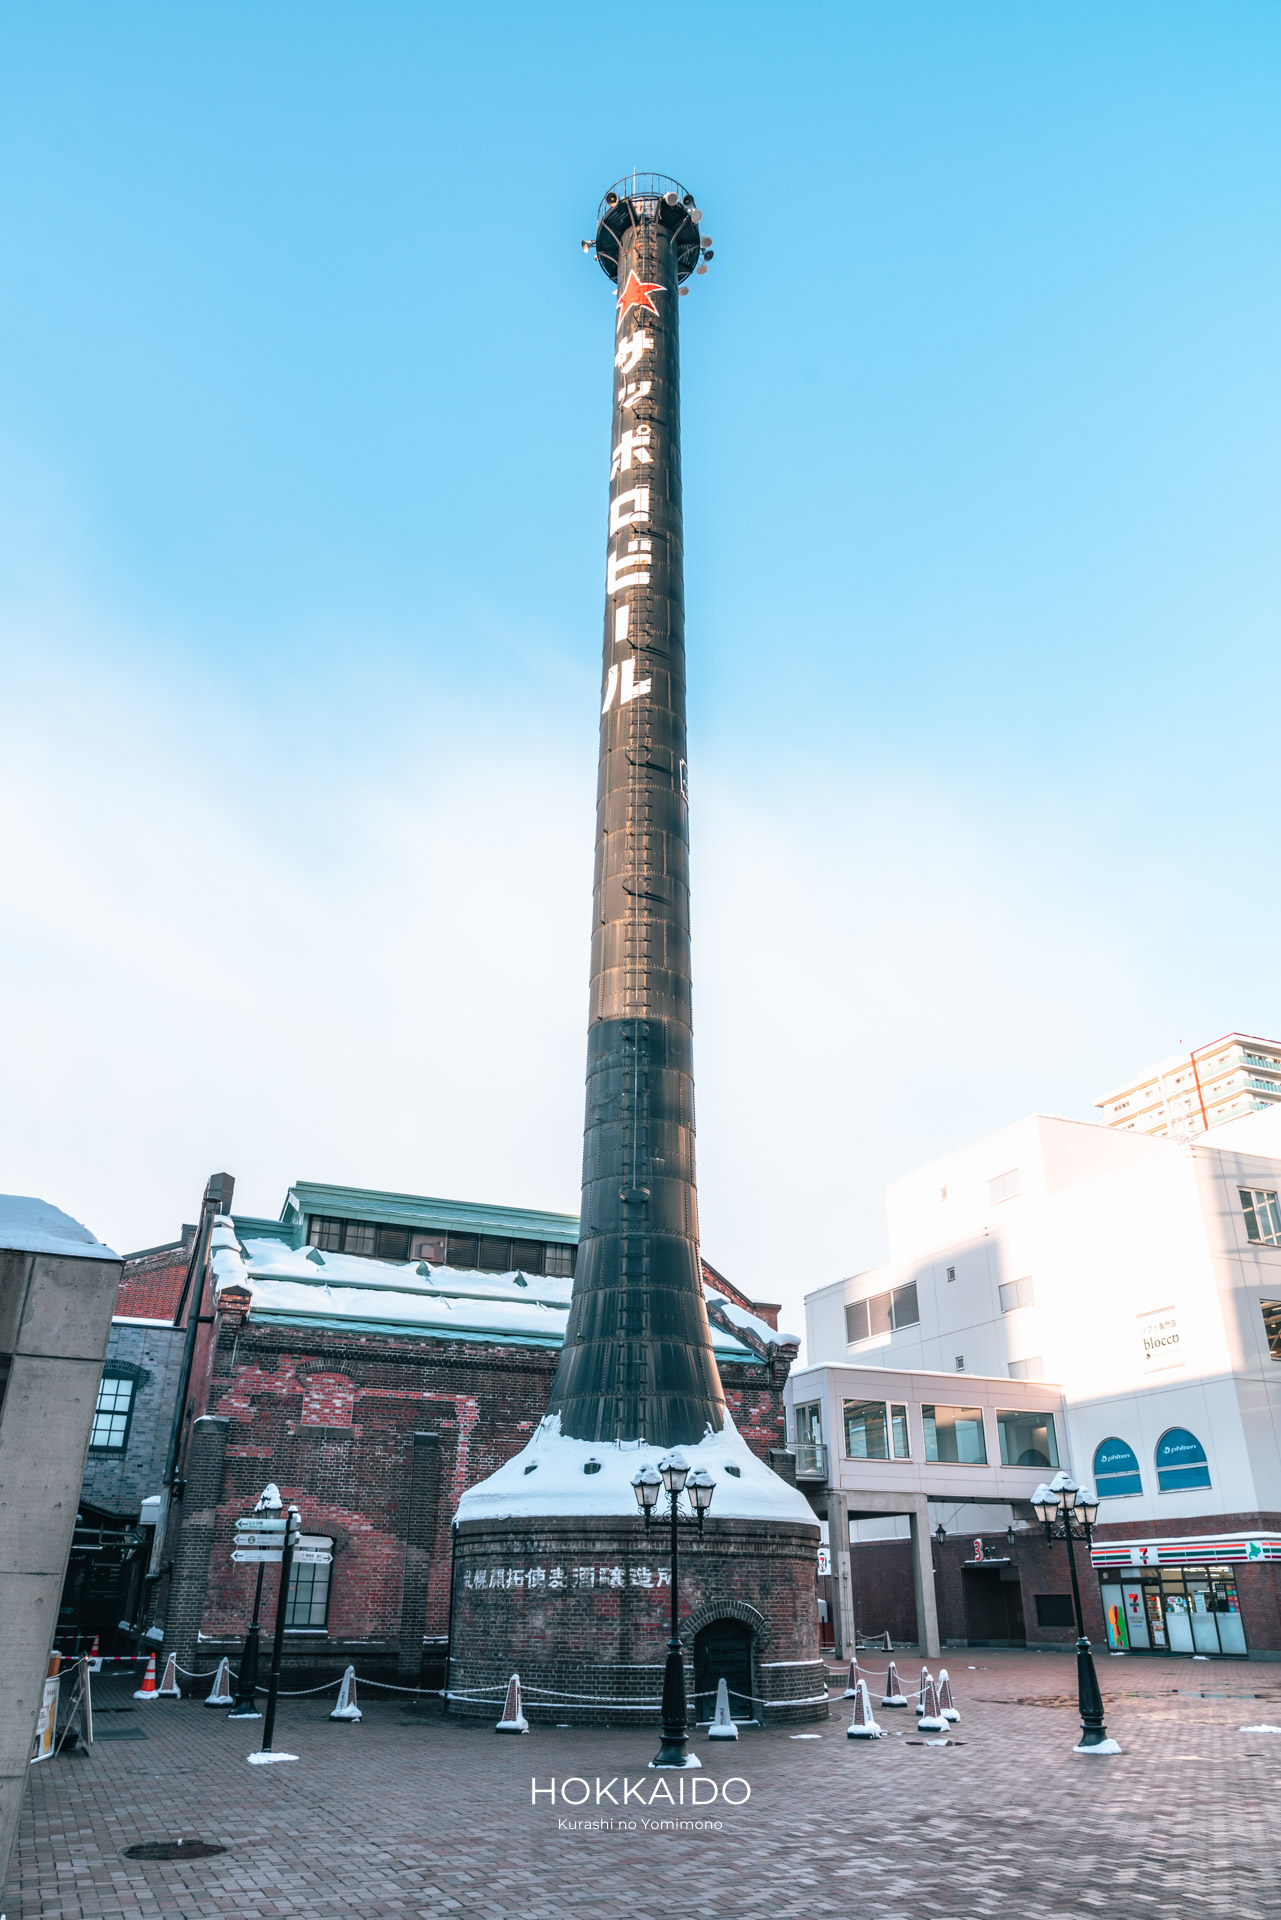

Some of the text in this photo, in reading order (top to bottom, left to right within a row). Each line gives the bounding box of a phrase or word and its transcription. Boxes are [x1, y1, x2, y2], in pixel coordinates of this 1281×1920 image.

[602, 329, 654, 715] サッポロビール
[973, 1539, 983, 1562] 3
